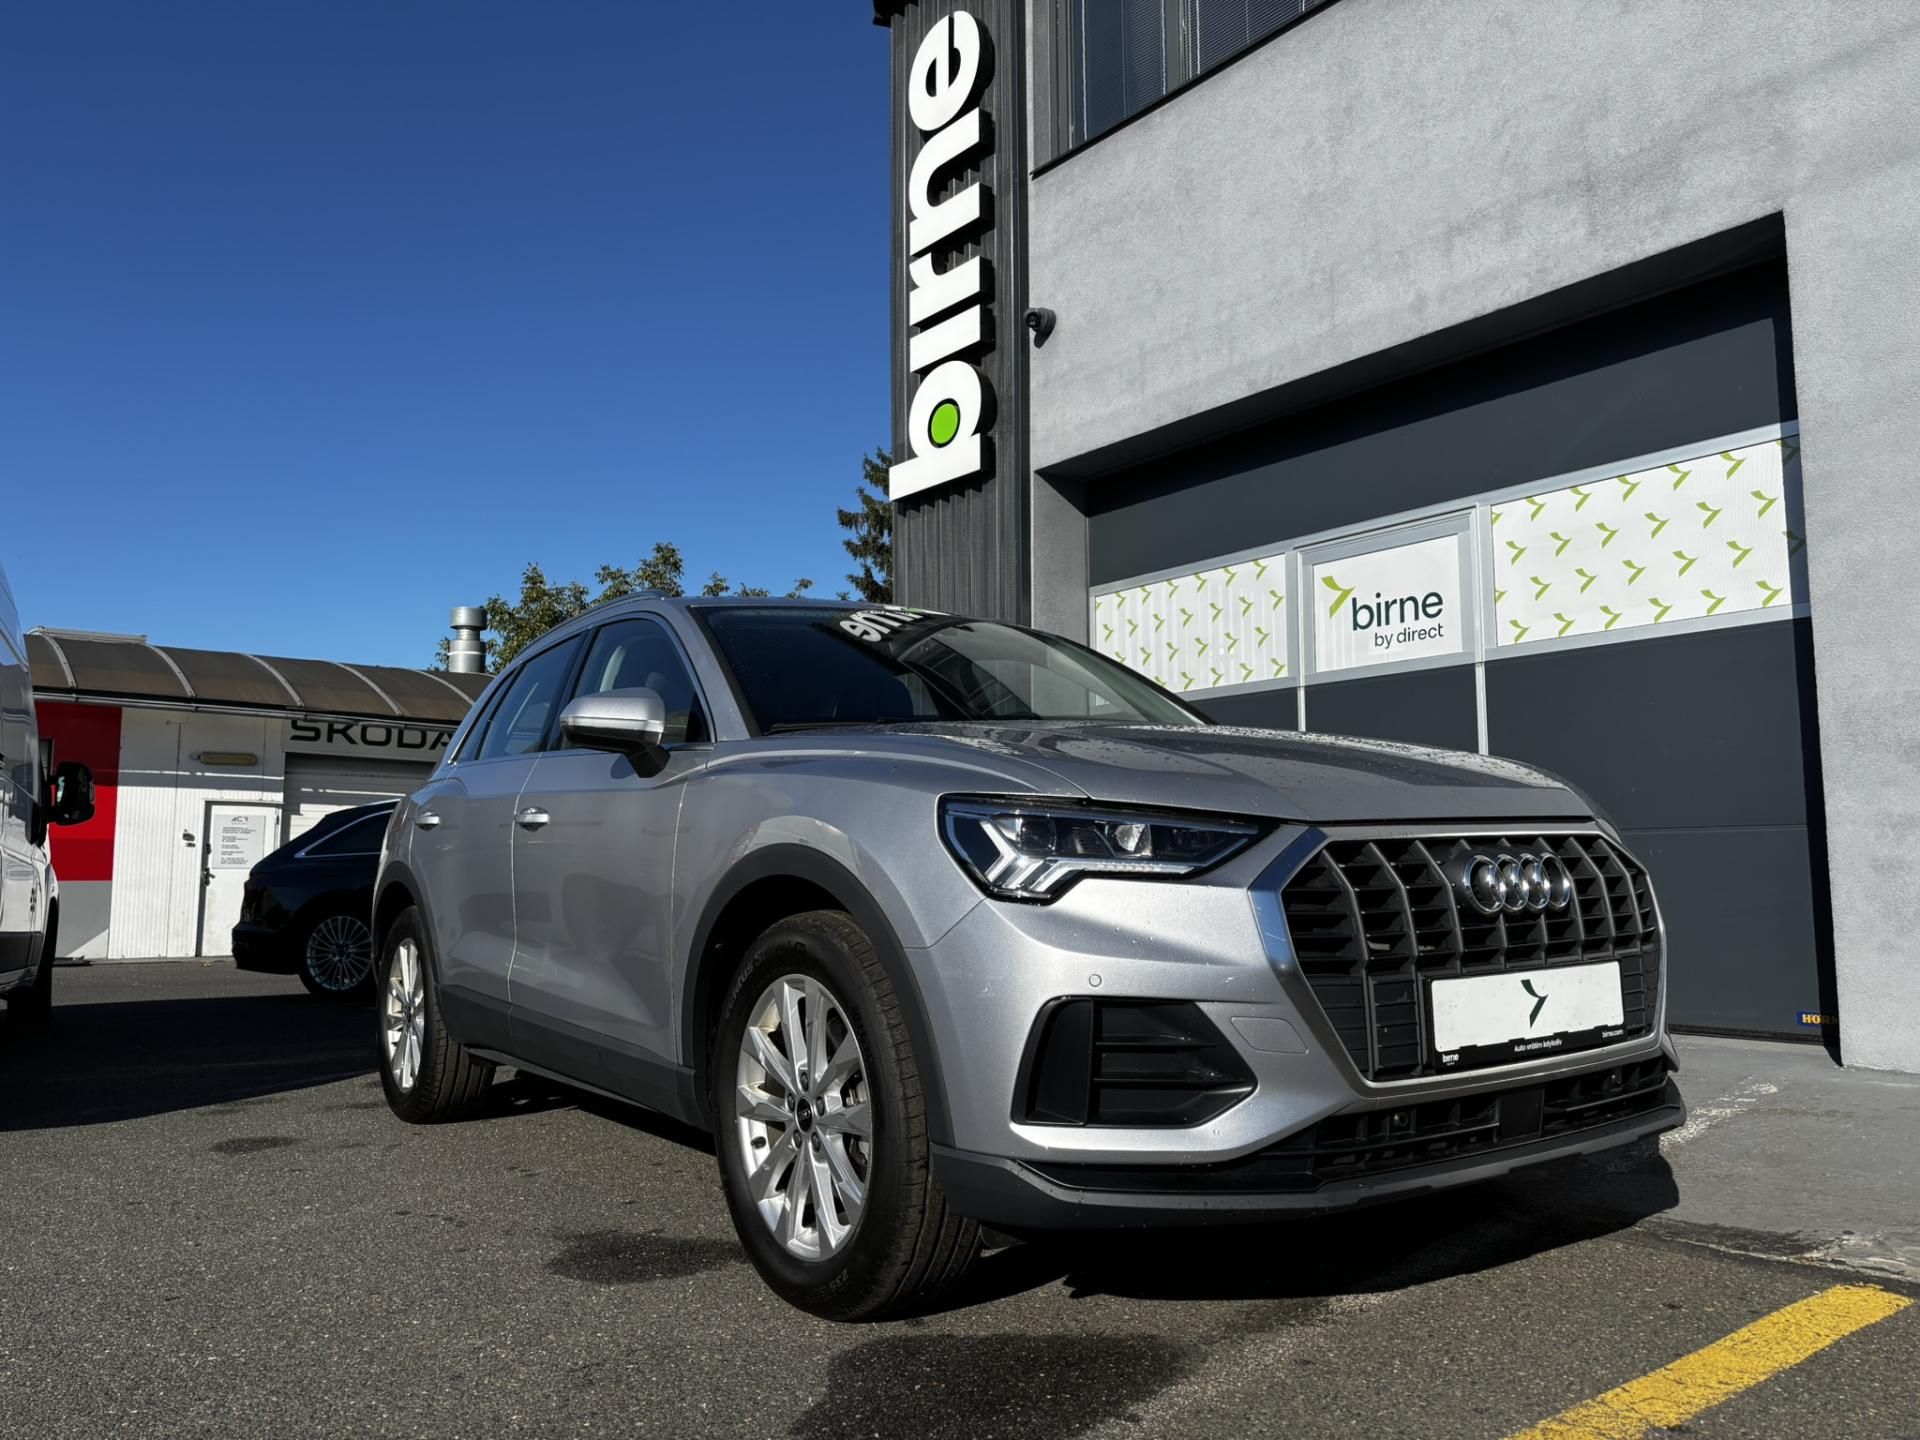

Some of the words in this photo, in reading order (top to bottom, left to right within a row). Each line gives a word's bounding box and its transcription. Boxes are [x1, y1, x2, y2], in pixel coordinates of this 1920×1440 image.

[889, 10, 981, 501] birne
[1352, 591, 1443, 631] birne
[1375, 633, 1393, 649] by
[1397, 624, 1443, 644] direct
